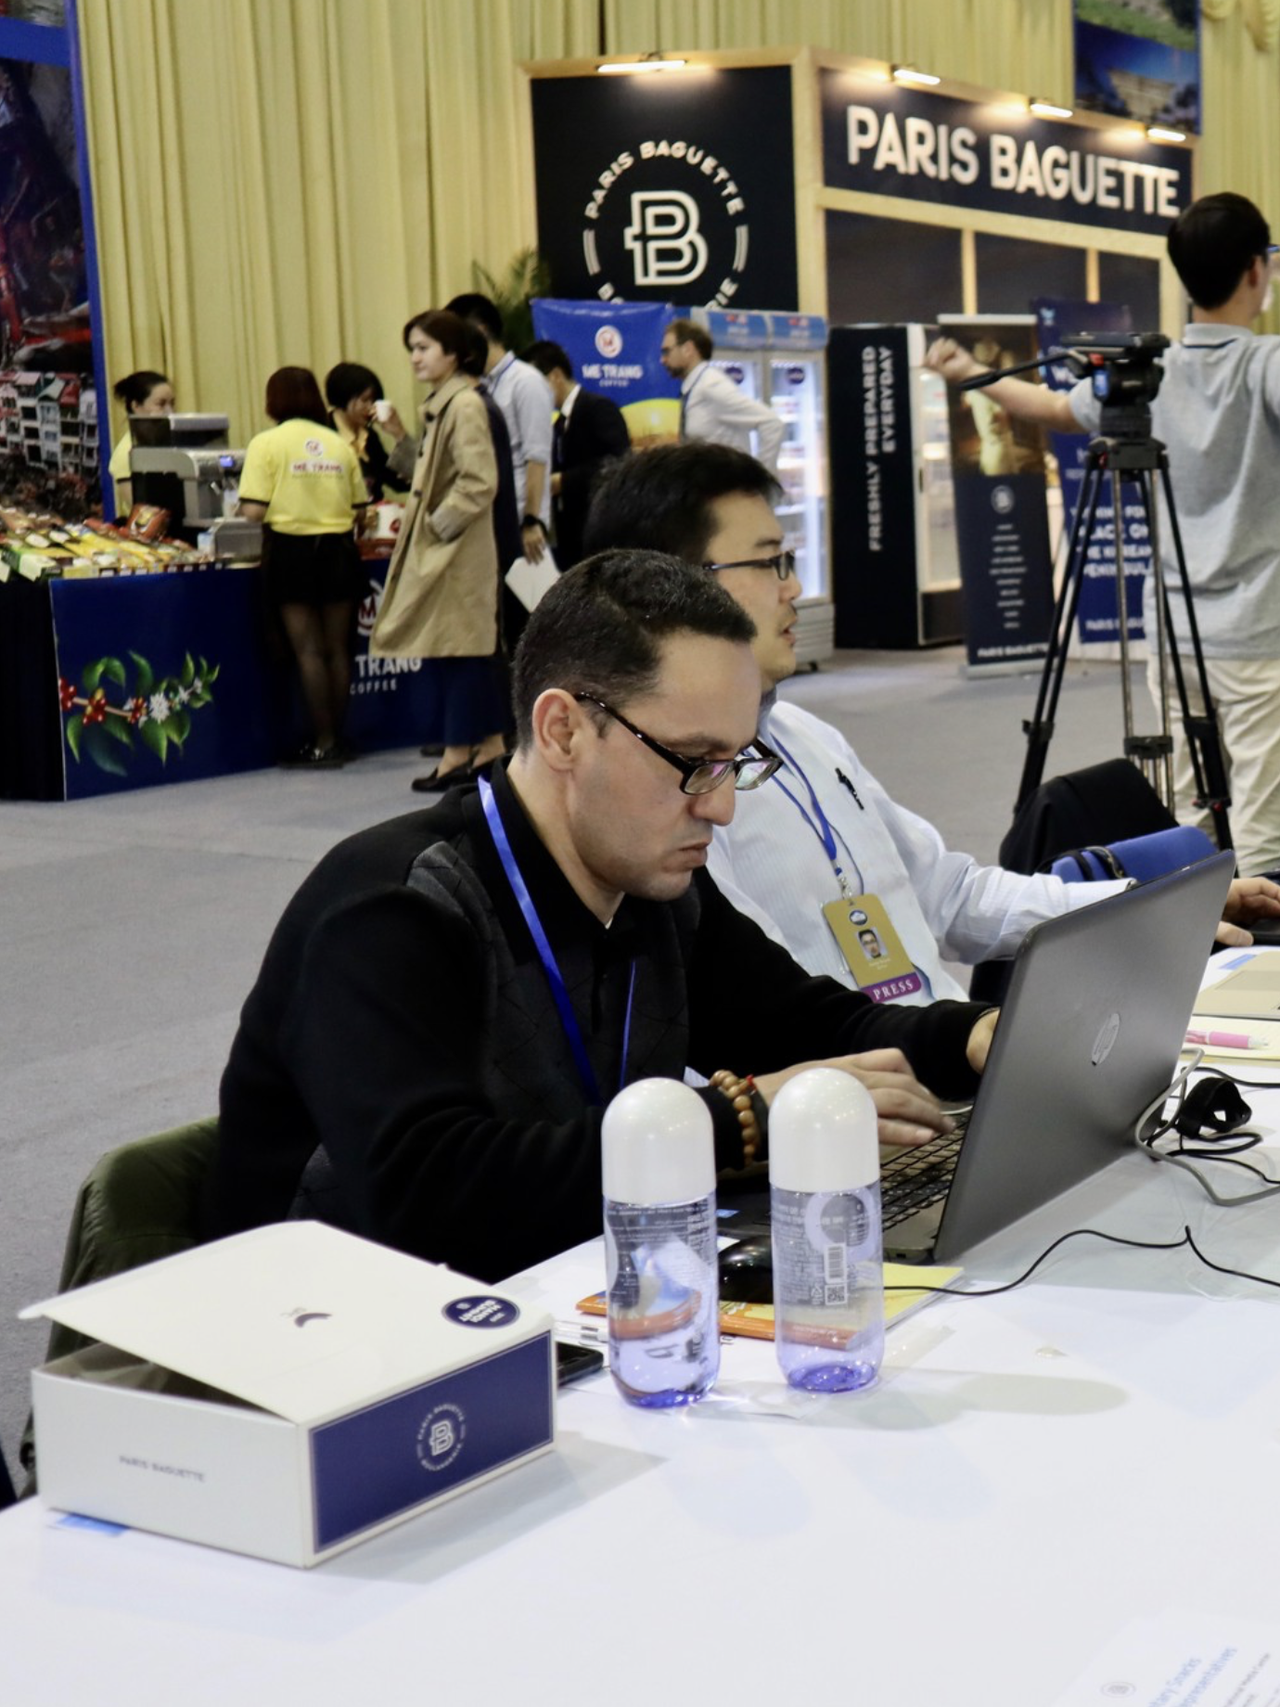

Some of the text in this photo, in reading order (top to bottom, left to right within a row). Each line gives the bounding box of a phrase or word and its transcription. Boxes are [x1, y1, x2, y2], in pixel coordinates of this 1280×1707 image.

[585, 139, 745, 220] PARIS BAGUETTE
[847, 104, 1181, 217] PARIS BAGUETTE
[602, 364, 643, 379] TRANG
[879, 346, 896, 453] EVERYDAY
[862, 346, 882, 551] FRESHLY PREPARED
[350, 678, 397, 696] COFFEE
[355, 655, 422, 678] TRANG
[872, 978, 914, 1001] PRESS
